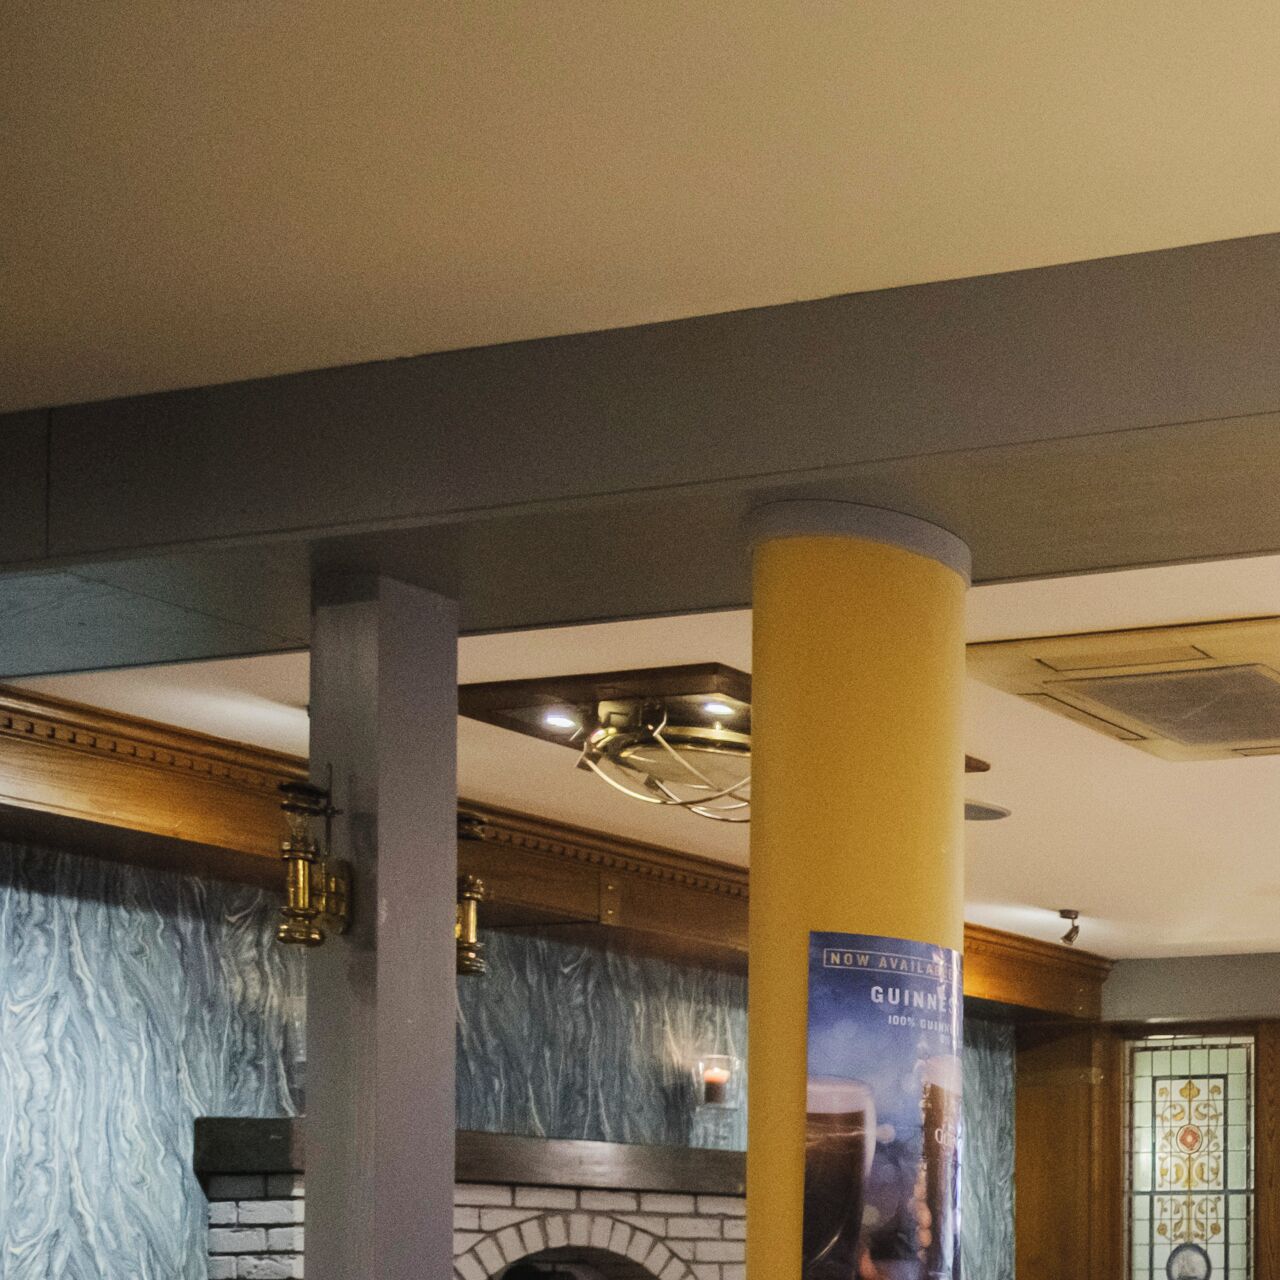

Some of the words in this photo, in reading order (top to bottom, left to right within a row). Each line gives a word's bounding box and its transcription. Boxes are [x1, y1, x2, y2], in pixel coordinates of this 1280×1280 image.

[830, 951, 869, 967] NOW
[870, 985, 959, 1014] GUINNES
[888, 1015, 915, 1027] 100%
